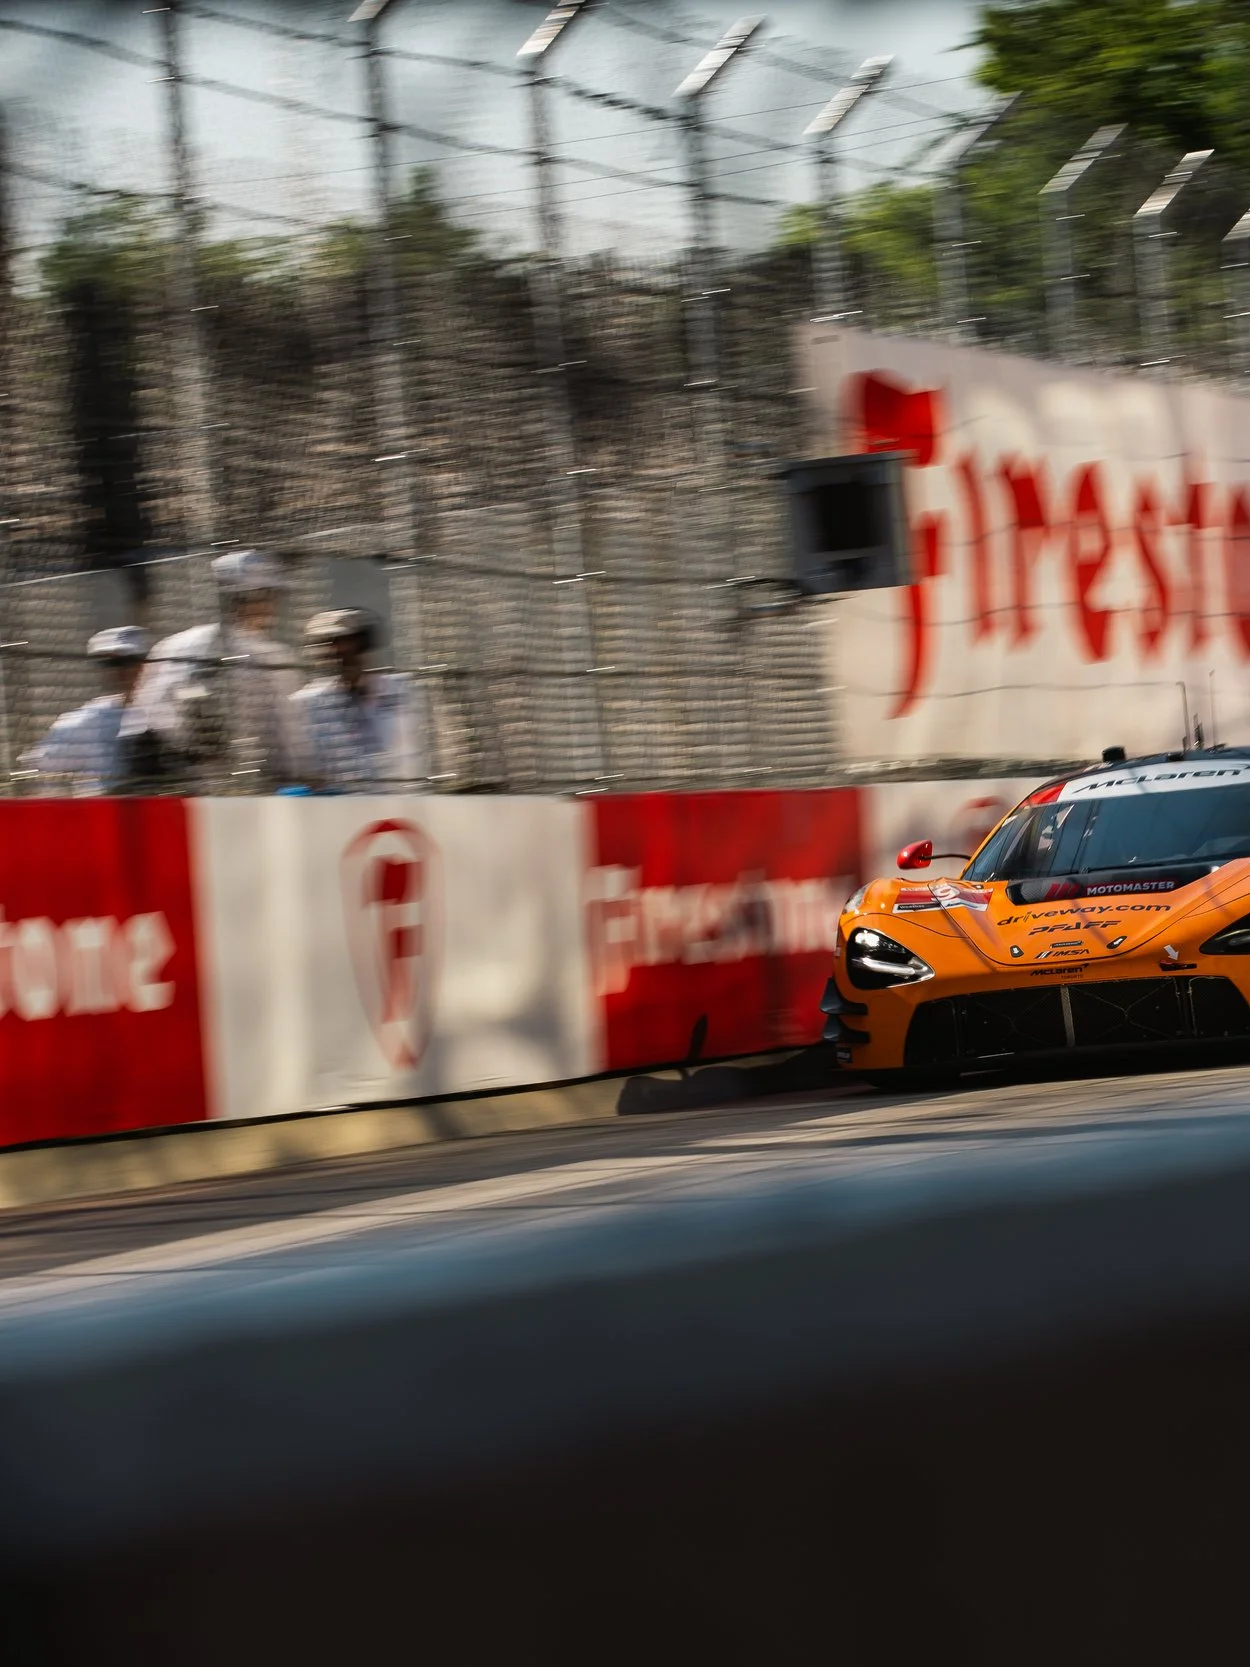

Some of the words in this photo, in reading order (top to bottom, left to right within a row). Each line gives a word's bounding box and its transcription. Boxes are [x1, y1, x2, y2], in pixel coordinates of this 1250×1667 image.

[1072, 766, 1246, 794] McLaren
[1086, 881, 1175, 896] MOTOMASTER
[996, 904, 1171, 926] driveway.com
[1028, 920, 1122, 936] PFAFF
[1052, 949, 1090, 957] IMSA
[1030, 965, 1085, 976] McLaren
